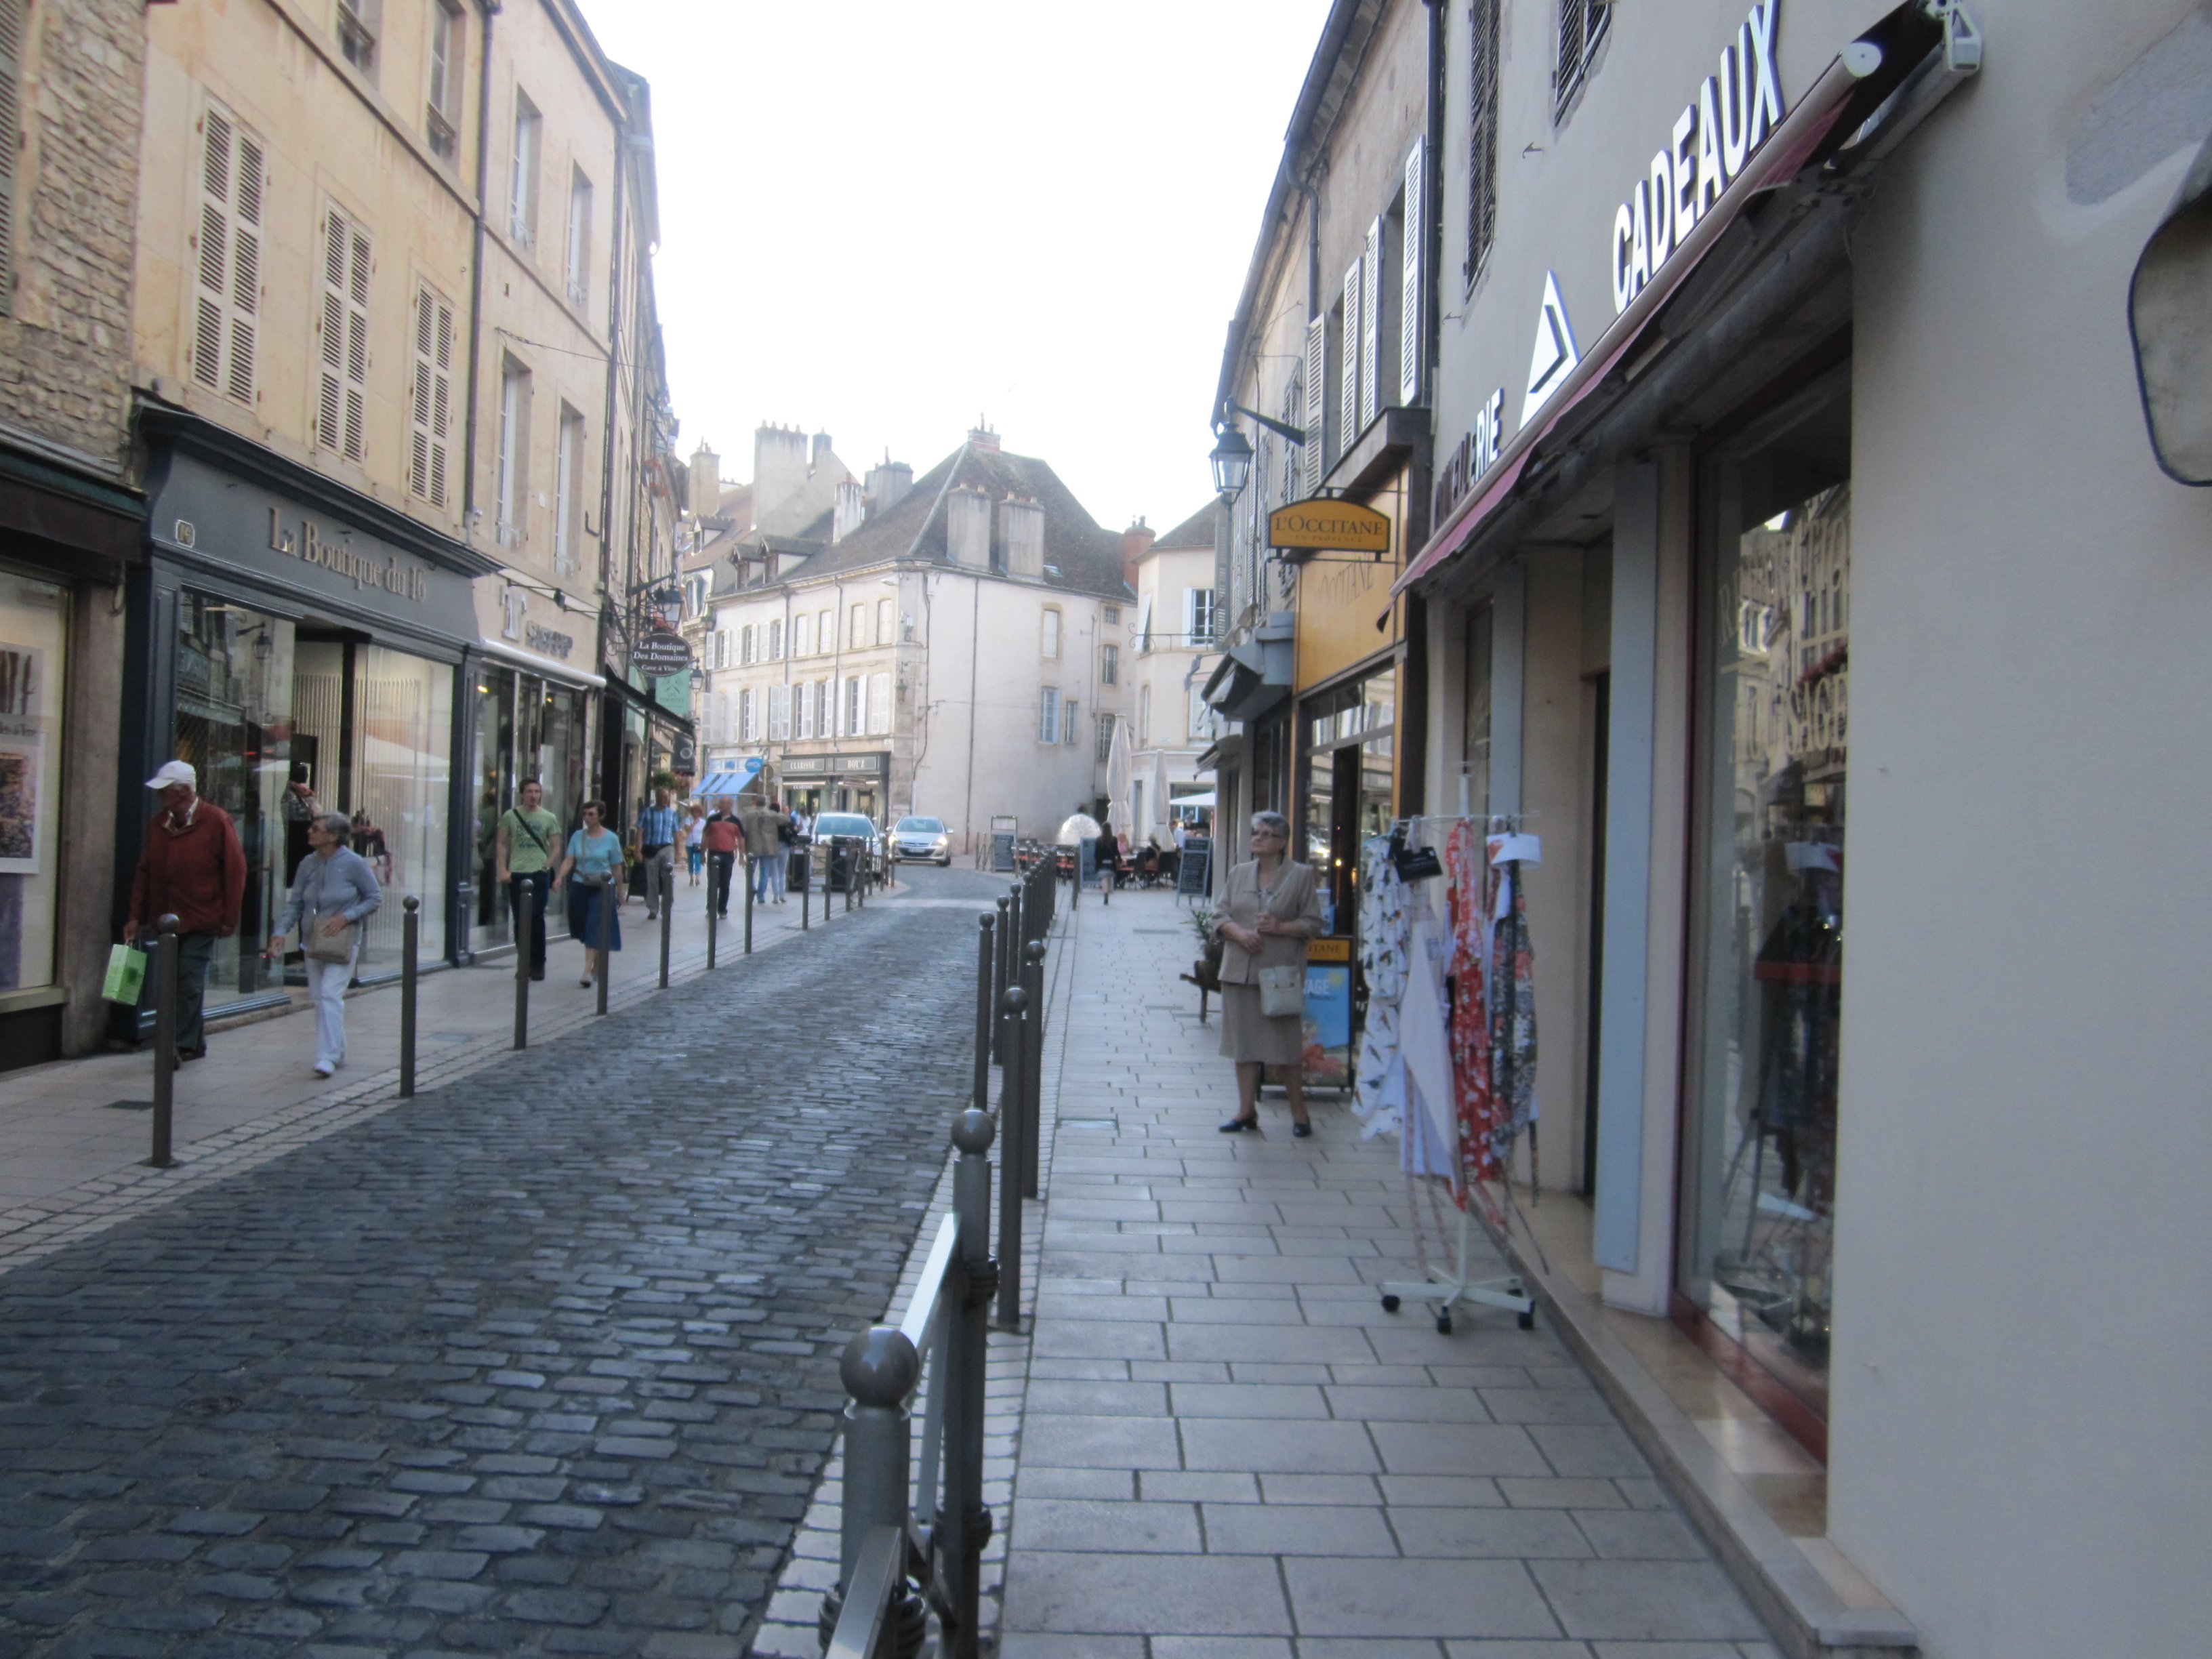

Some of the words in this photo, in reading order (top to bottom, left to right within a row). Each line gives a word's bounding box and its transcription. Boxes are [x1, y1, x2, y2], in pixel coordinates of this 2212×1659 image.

[1613, 0, 1785, 314] CADEAUX
[1275, 515, 1383, 535] L'OCCITANE
[269, 508, 298, 557] La
[302, 520, 382, 591] Boutique
[385, 556, 407, 596] du
[409, 566, 427, 602] 16
[639, 641, 649, 649] La
[651, 642, 685, 653] Boutique
[634, 651, 649, 659] Des
[651, 653, 689, 661] Domaines
[790, 760, 815, 770] CLARISSE
